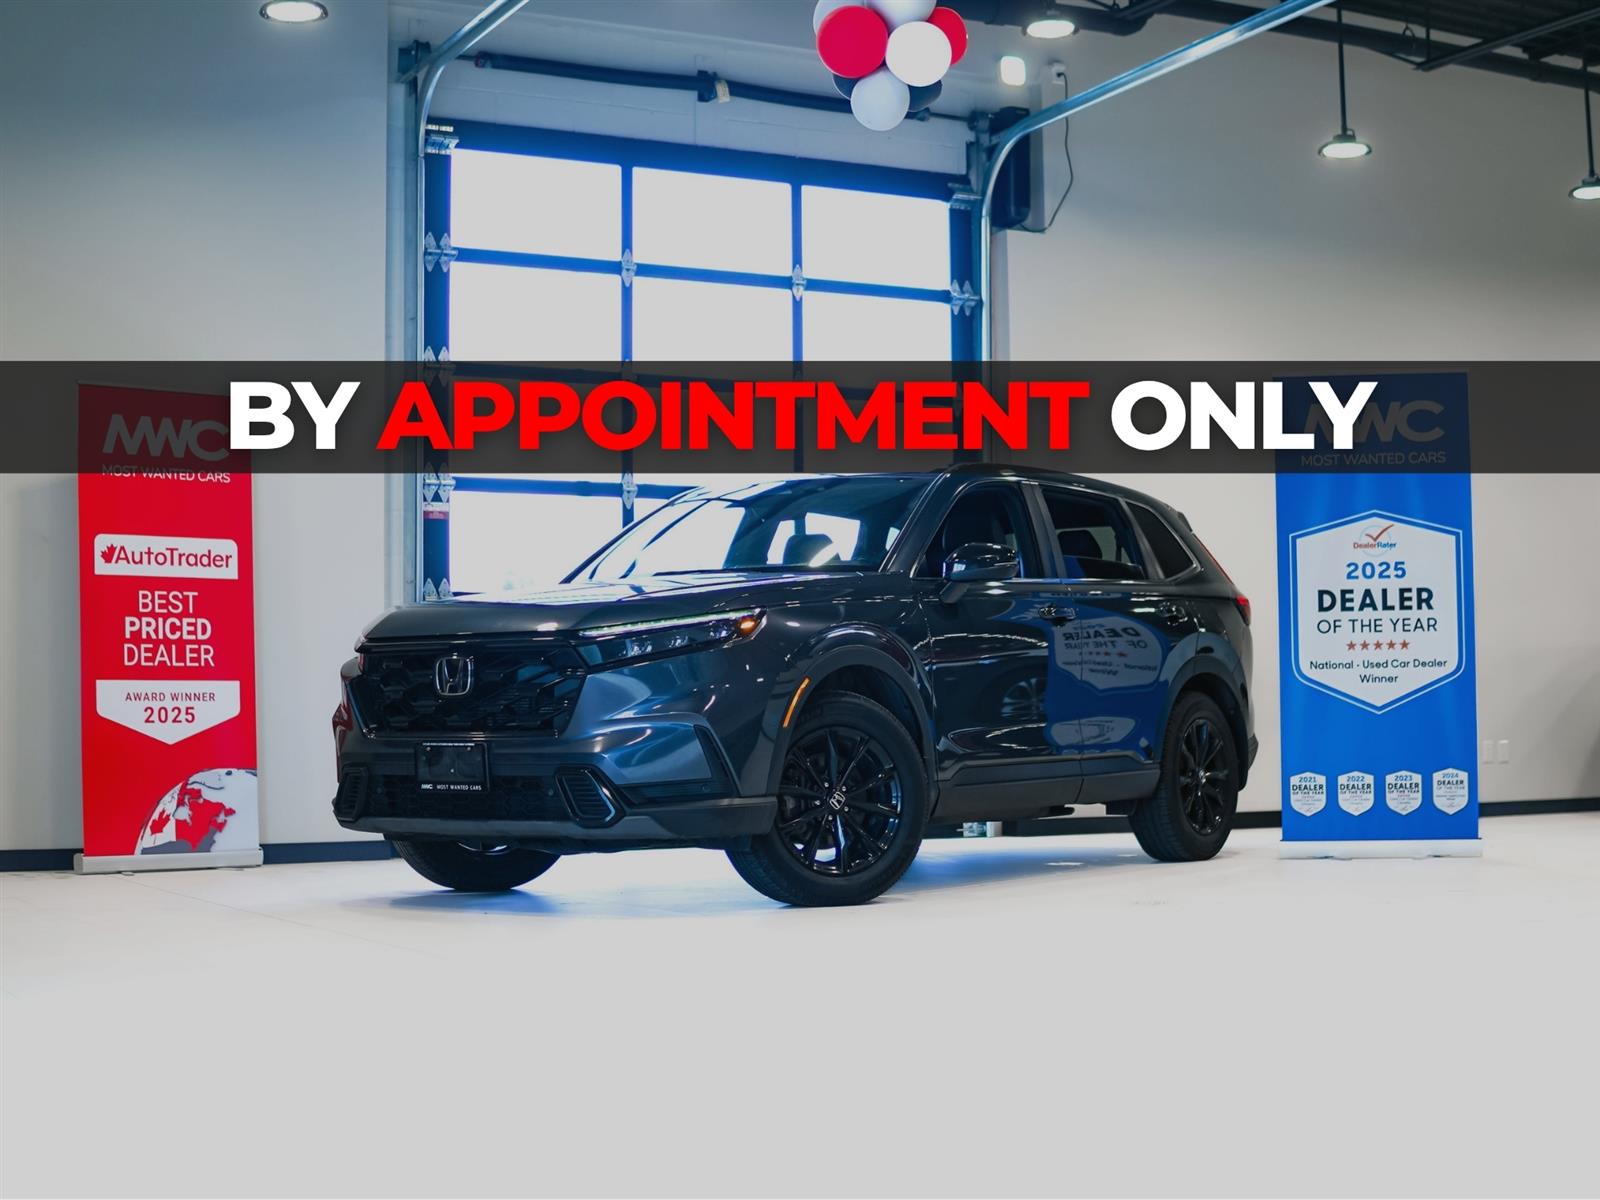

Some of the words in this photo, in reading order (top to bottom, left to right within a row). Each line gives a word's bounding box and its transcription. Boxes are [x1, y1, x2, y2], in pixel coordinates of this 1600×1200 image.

[102, 414, 229, 461] MWC
[1301, 454, 1341, 467] MOST
[1344, 452, 1405, 465] WANTED
[1408, 451, 1447, 464] CARS
[102, 464, 138, 478] MOST
[141, 466, 195, 481] WANTED
[197, 471, 231, 484] CARS
[1353, 540, 1397, 550] DealerRater
[114, 545, 233, 569] AutoTrader
[1345, 560, 1407, 580] 2025
[138, 590, 199, 614] BEST
[1316, 587, 1435, 613] DEALER
[124, 616, 212, 641] PRICED
[1316, 618, 1342, 634] OF
[1348, 618, 1383, 633] THE
[1389, 617, 1438, 632] YEAR
[123, 643, 216, 668] DEALER
[1309, 660, 1354, 670] National
[1362, 659, 1389, 669] Used
[1393, 659, 1411, 668] Car
[1413, 658, 1448, 668] Dealer
[1359, 673, 1399, 684] Winner
[125, 692, 166, 702] AWARD
[170, 692, 216, 702] WINNER
[143, 706, 196, 724] 2025
[1339, 783, 1372, 791] DEALER
[1387, 782, 1420, 790] DEALER
